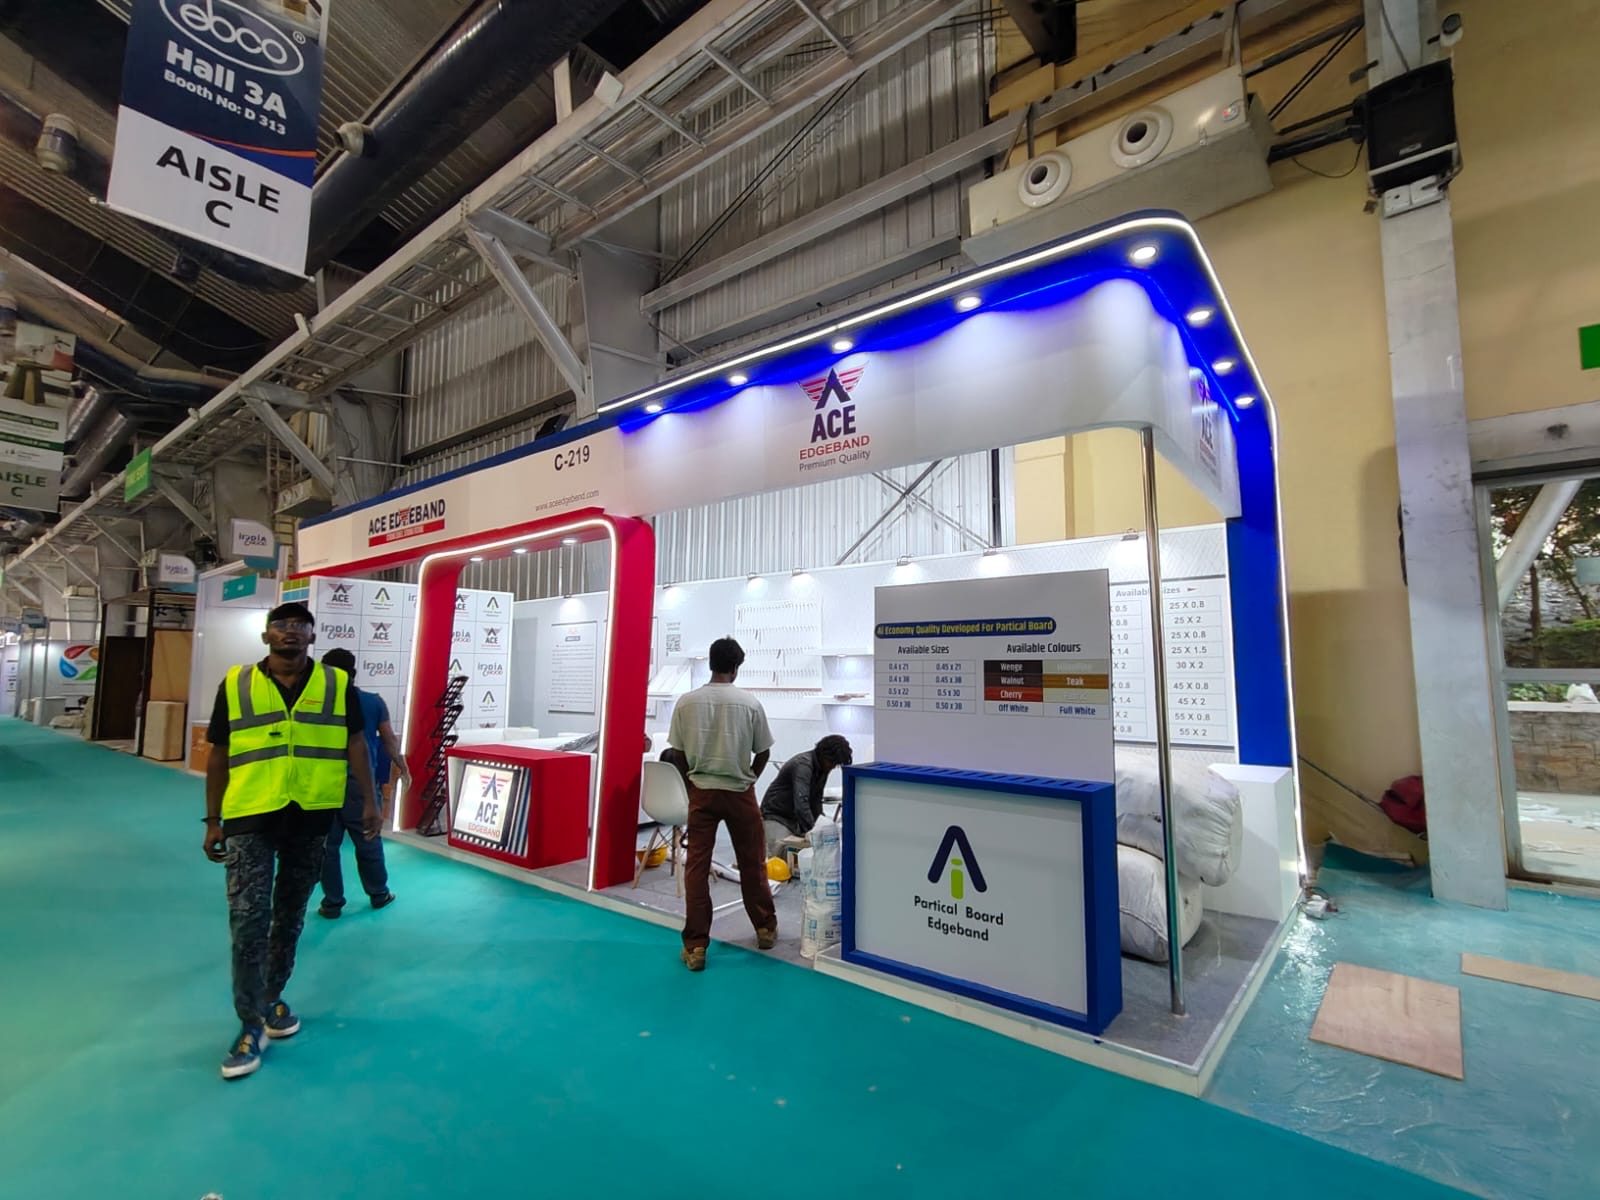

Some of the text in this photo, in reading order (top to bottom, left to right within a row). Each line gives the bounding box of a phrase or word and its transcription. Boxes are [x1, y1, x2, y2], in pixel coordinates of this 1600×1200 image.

[166, 40, 287, 120] Hall 3A
[164, 69, 286, 135] Booth No: D 313
[156, 146, 280, 214] AISLE
[205, 200, 233, 228] C
[811, 404, 856, 443] ACE
[799, 435, 870, 460] EDGEBAND
[554, 444, 590, 471] C-219
[799, 450, 871, 472] Premium Quality
[0, 471, 47, 488] ISLE
[11, 486, 24, 498] C
[368, 515, 386, 536] ACE
[331, 594, 350, 602] ACE
[1191, 600, 1205, 608] 0.8
[373, 632, 389, 640] ACE
[886, 626, 914, 636] Economy
[916, 624, 940, 634] Quality
[942, 623, 980, 633] Developed
[982, 623, 994, 632] For
[996, 622, 1026, 632] Partical
[1028, 620, 1054, 630] Board
[898, 644, 950, 654] Available Sizes
[1006, 642, 1081, 654] Available Colours
[1000, 663, 1023, 672] Wenge
[1001, 676, 1024, 685] Walnut
[1066, 677, 1084, 686] Teak
[1000, 690, 1022, 700] Cherry
[998, 704, 1029, 712] Off White
[1060, 706, 1096, 715] Full White
[1179, 728, 1190, 736] 55
[475, 801, 498, 825] ACE
[914, 896, 1004, 926] Partical Board
[928, 916, 989, 941] Edgeband
